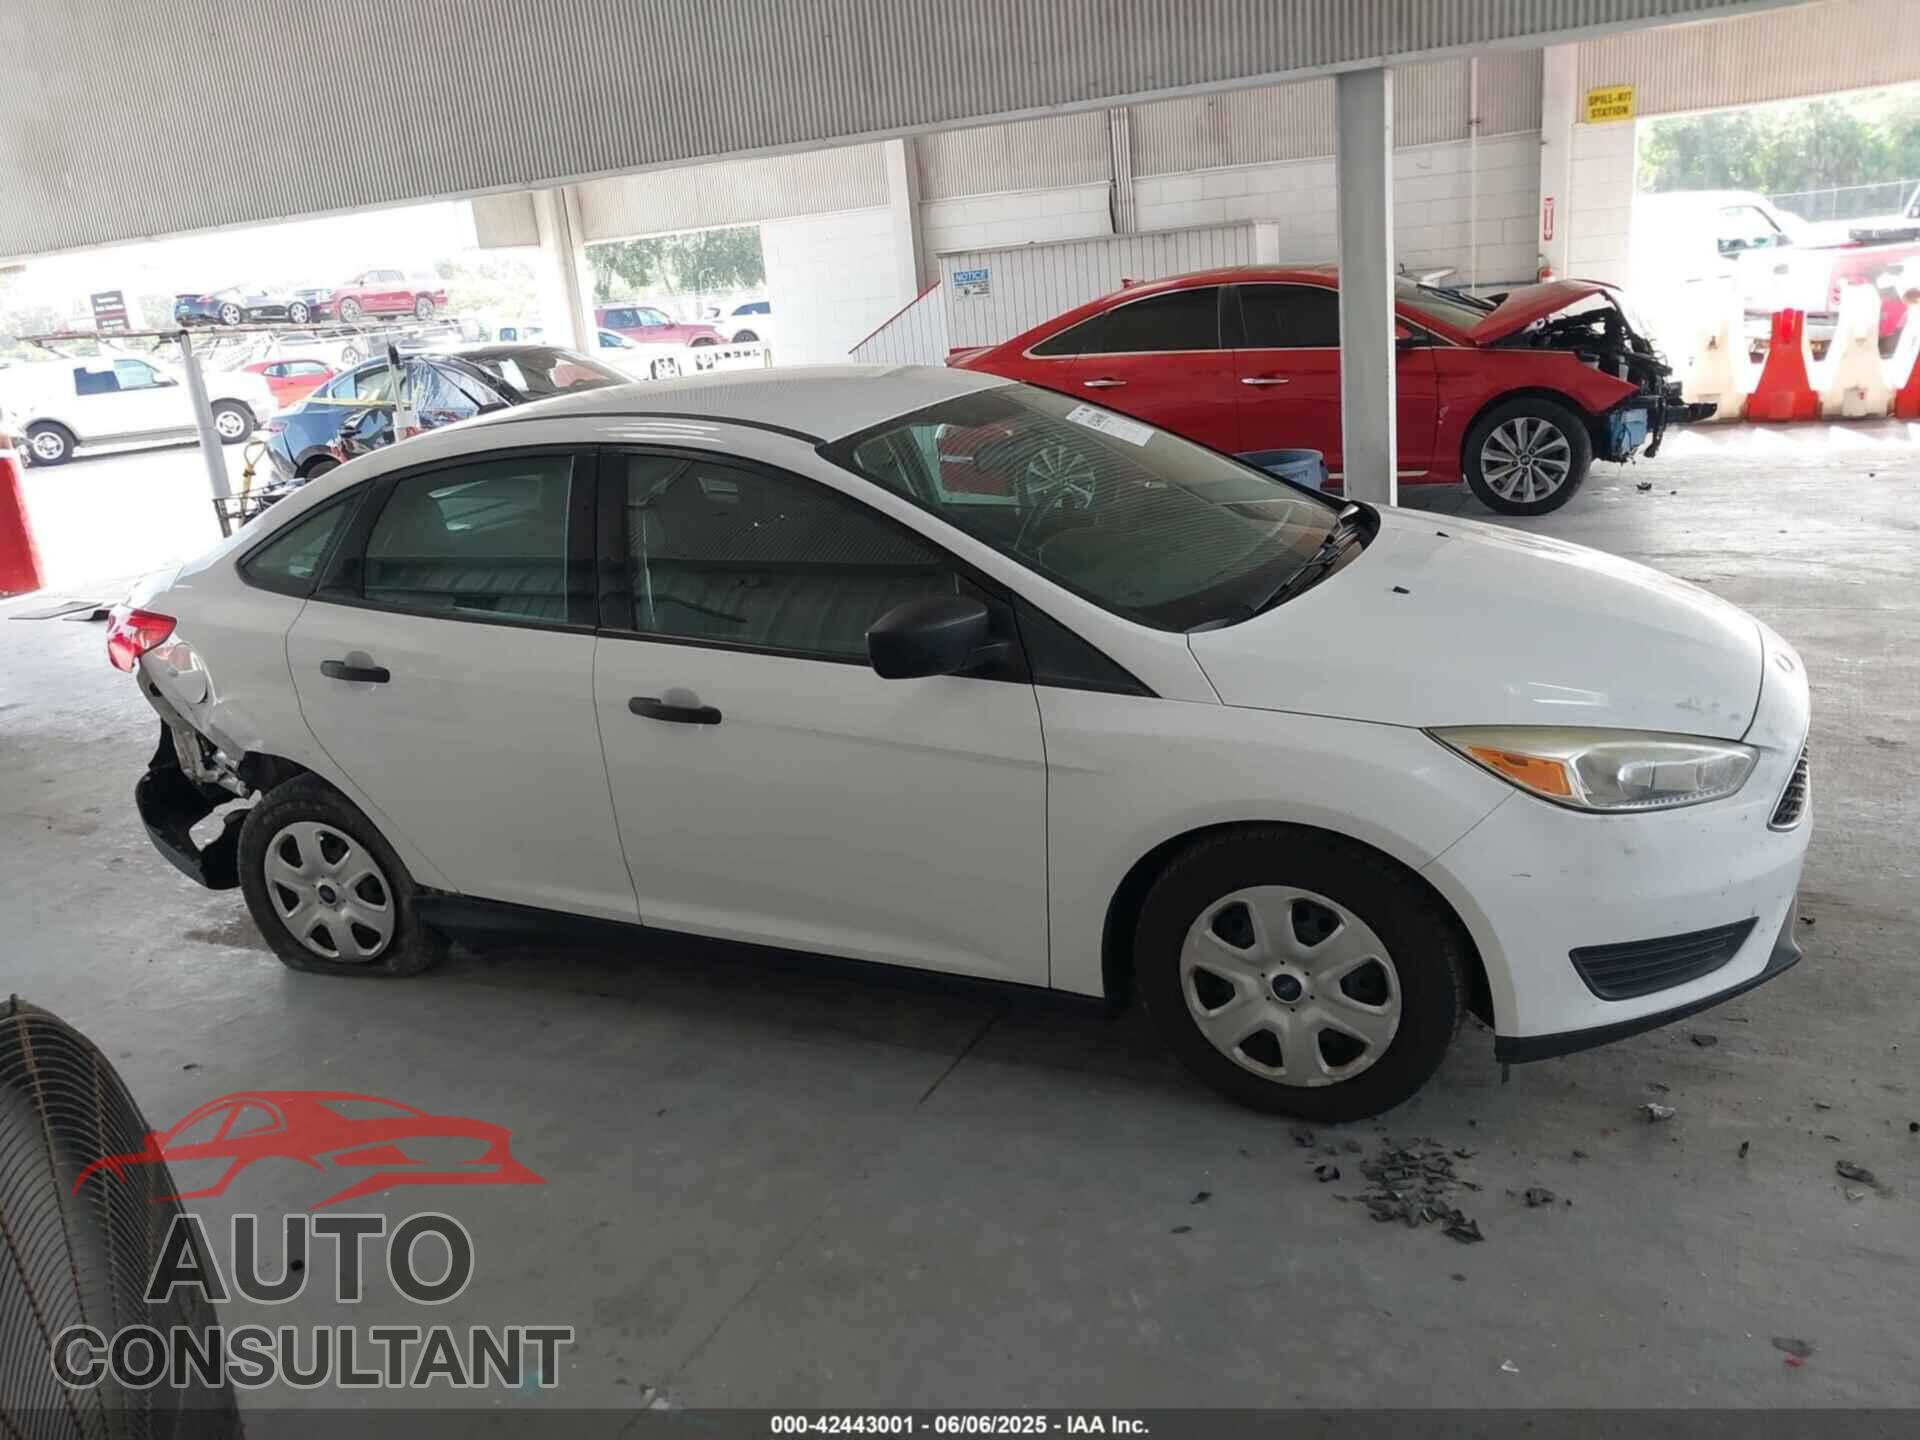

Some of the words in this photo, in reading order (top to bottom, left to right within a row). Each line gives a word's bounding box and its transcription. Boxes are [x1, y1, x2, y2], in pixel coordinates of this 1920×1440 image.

[1588, 91, 1632, 106] SPILL-KIT
[1591, 105, 1628, 119] STATION
[954, 270, 988, 282] NOTICE
